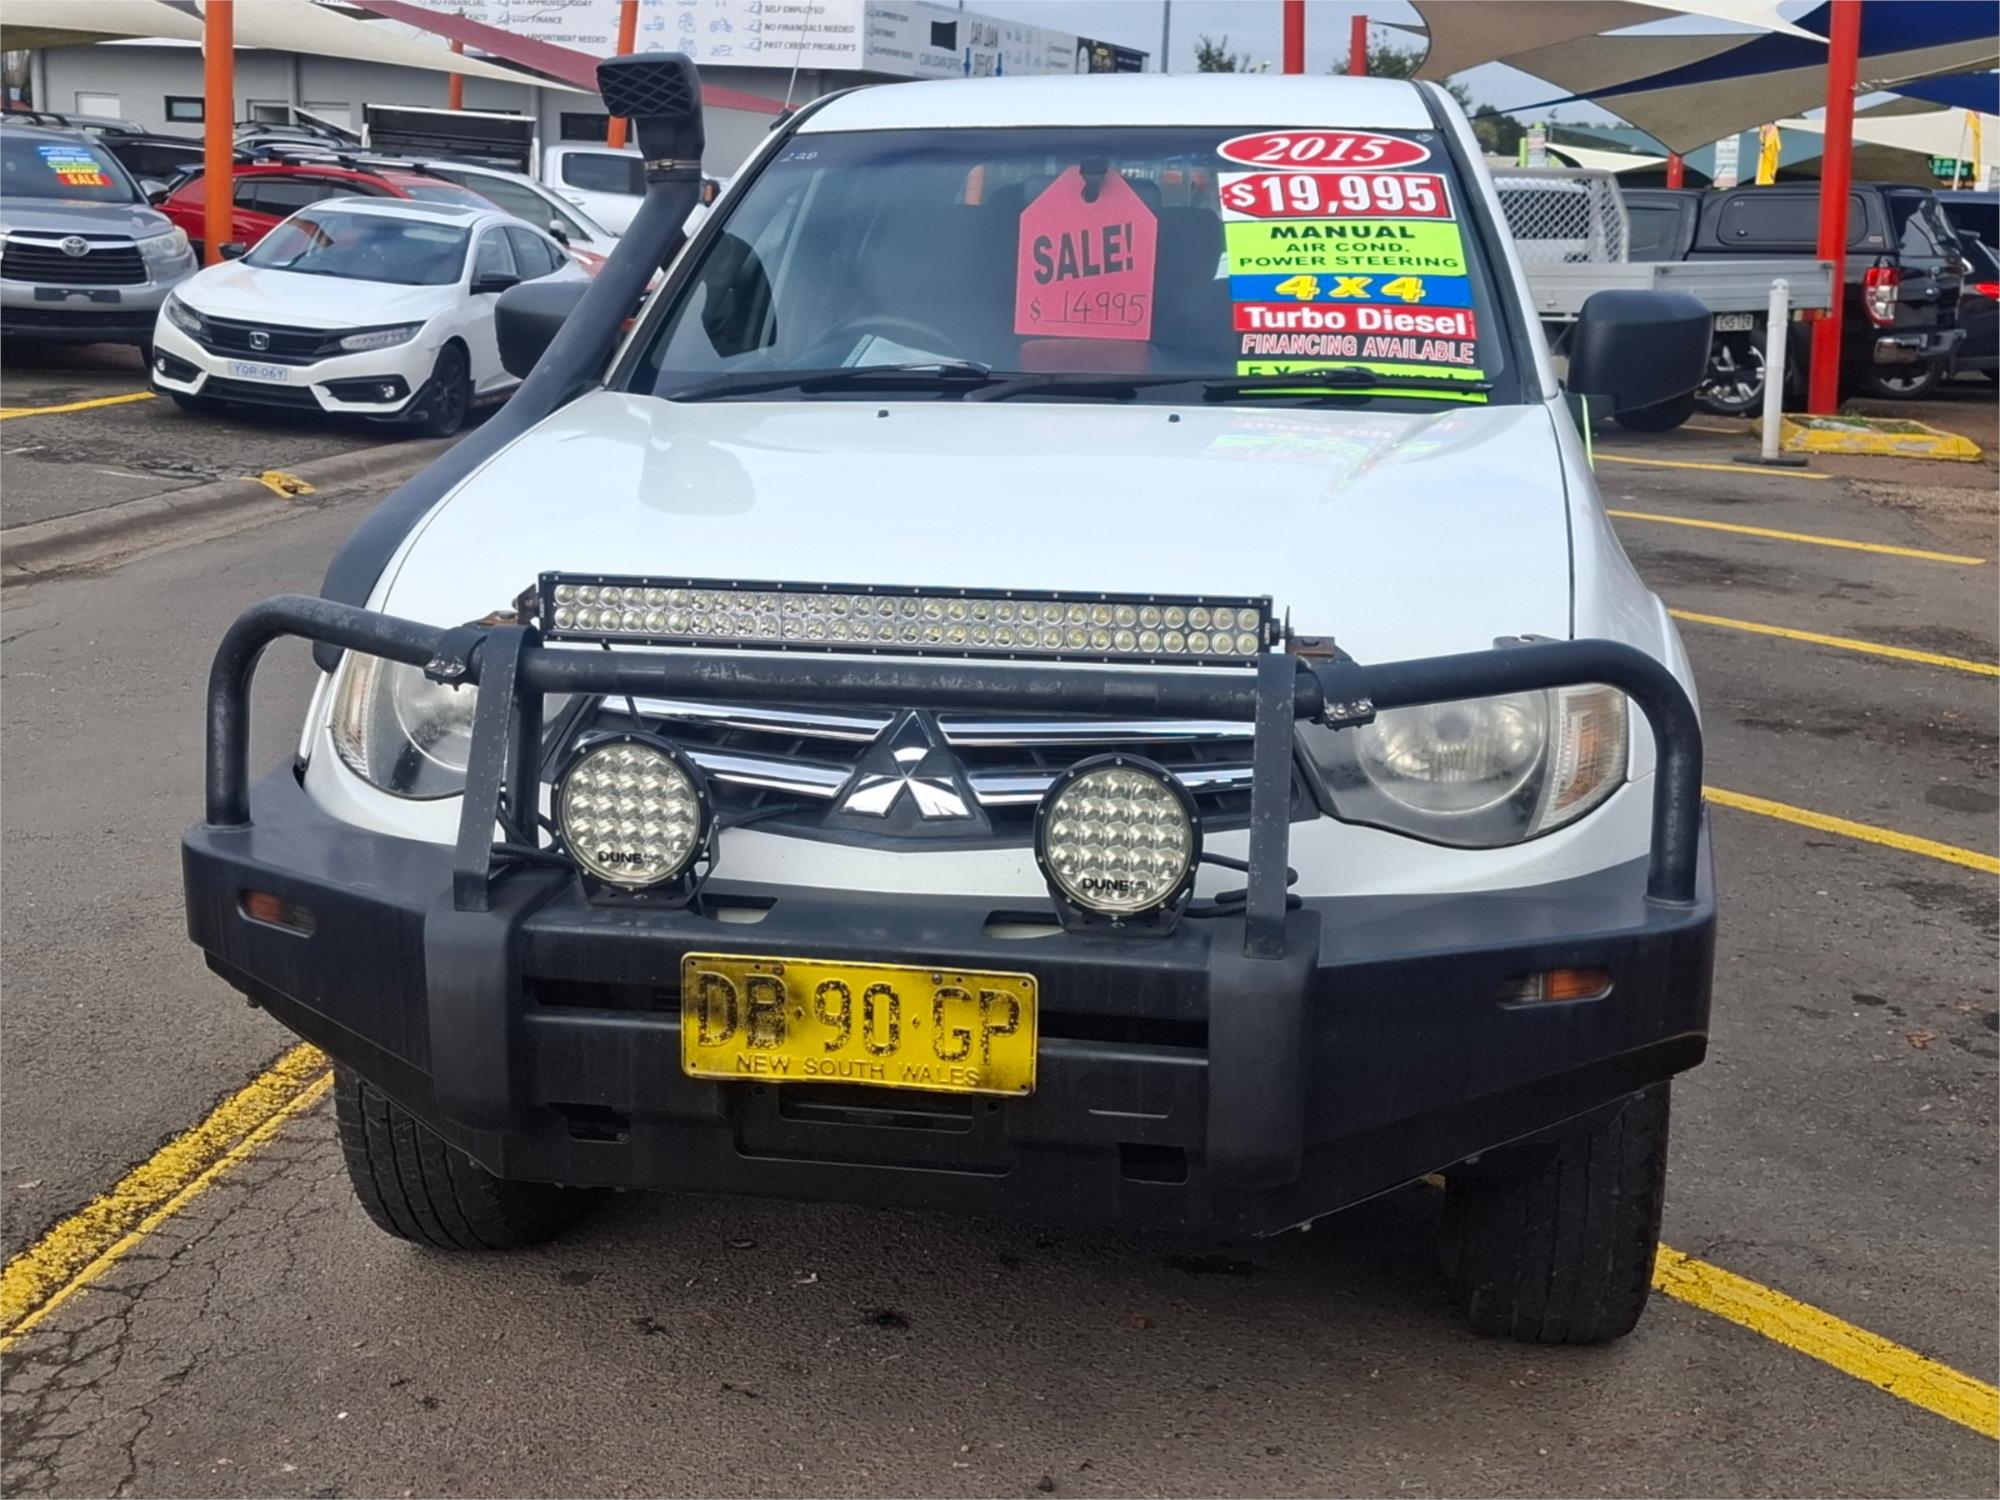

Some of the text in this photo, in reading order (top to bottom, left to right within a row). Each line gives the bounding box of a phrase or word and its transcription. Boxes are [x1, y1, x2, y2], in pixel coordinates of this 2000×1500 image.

[764, 5, 782, 13] SELF
[764, 23, 776, 31] NO
[578, 35, 608, 44] NEEDED
[764, 41, 782, 49] PAST
[1251, 137, 1392, 162] 2015
[67, 173, 104, 185] SALE
[1270, 226, 1416, 239] MANUAL
[1033, 222, 1134, 285] SALE!
[1286, 243, 1410, 252] AIR COND.
[1240, 256, 1459, 268] POWER STEERING
[1063, 290, 1147, 325] 14995
[1244, 307, 1467, 335] Turbo Diesel
[1241, 334, 1474, 363] FINANCING AVAILABLE
[598, 850, 643, 864] DUNE
[1082, 877, 1129, 892] DUNE
[736, 1054, 981, 1087] NEW SOUTH WALES
